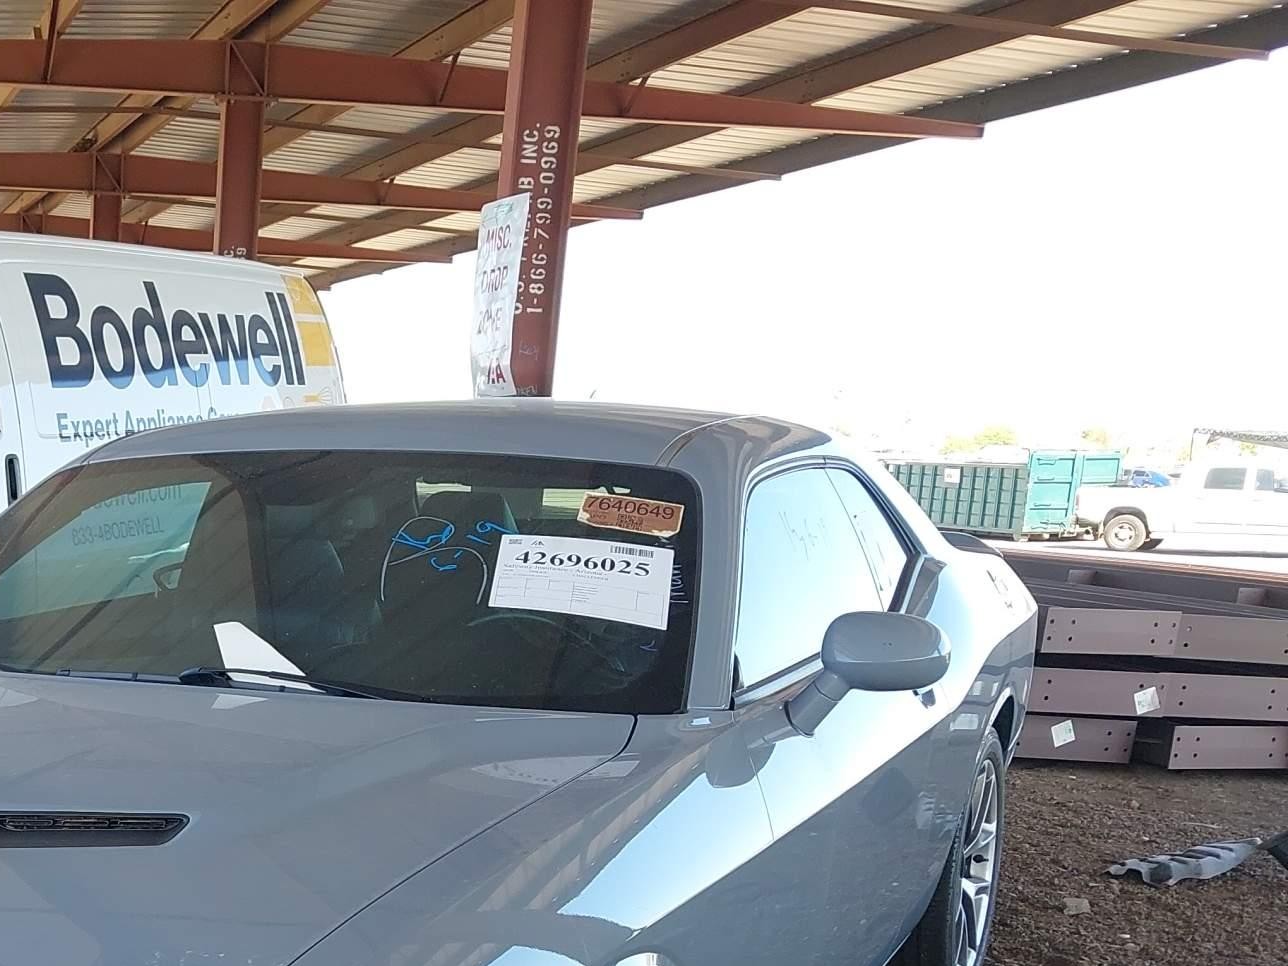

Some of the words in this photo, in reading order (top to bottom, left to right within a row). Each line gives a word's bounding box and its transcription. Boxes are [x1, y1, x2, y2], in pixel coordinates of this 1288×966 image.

[520, 122, 541, 164] INC.
[527, 125, 561, 314] 1-866-799-0969
[485, 224, 512, 251] MISC.
[23, 272, 306, 390] Bodewell
[56, 412, 121, 447] Expert
[587, 497, 675, 520] 7640649
[515, 550, 652, 577] 42696025
